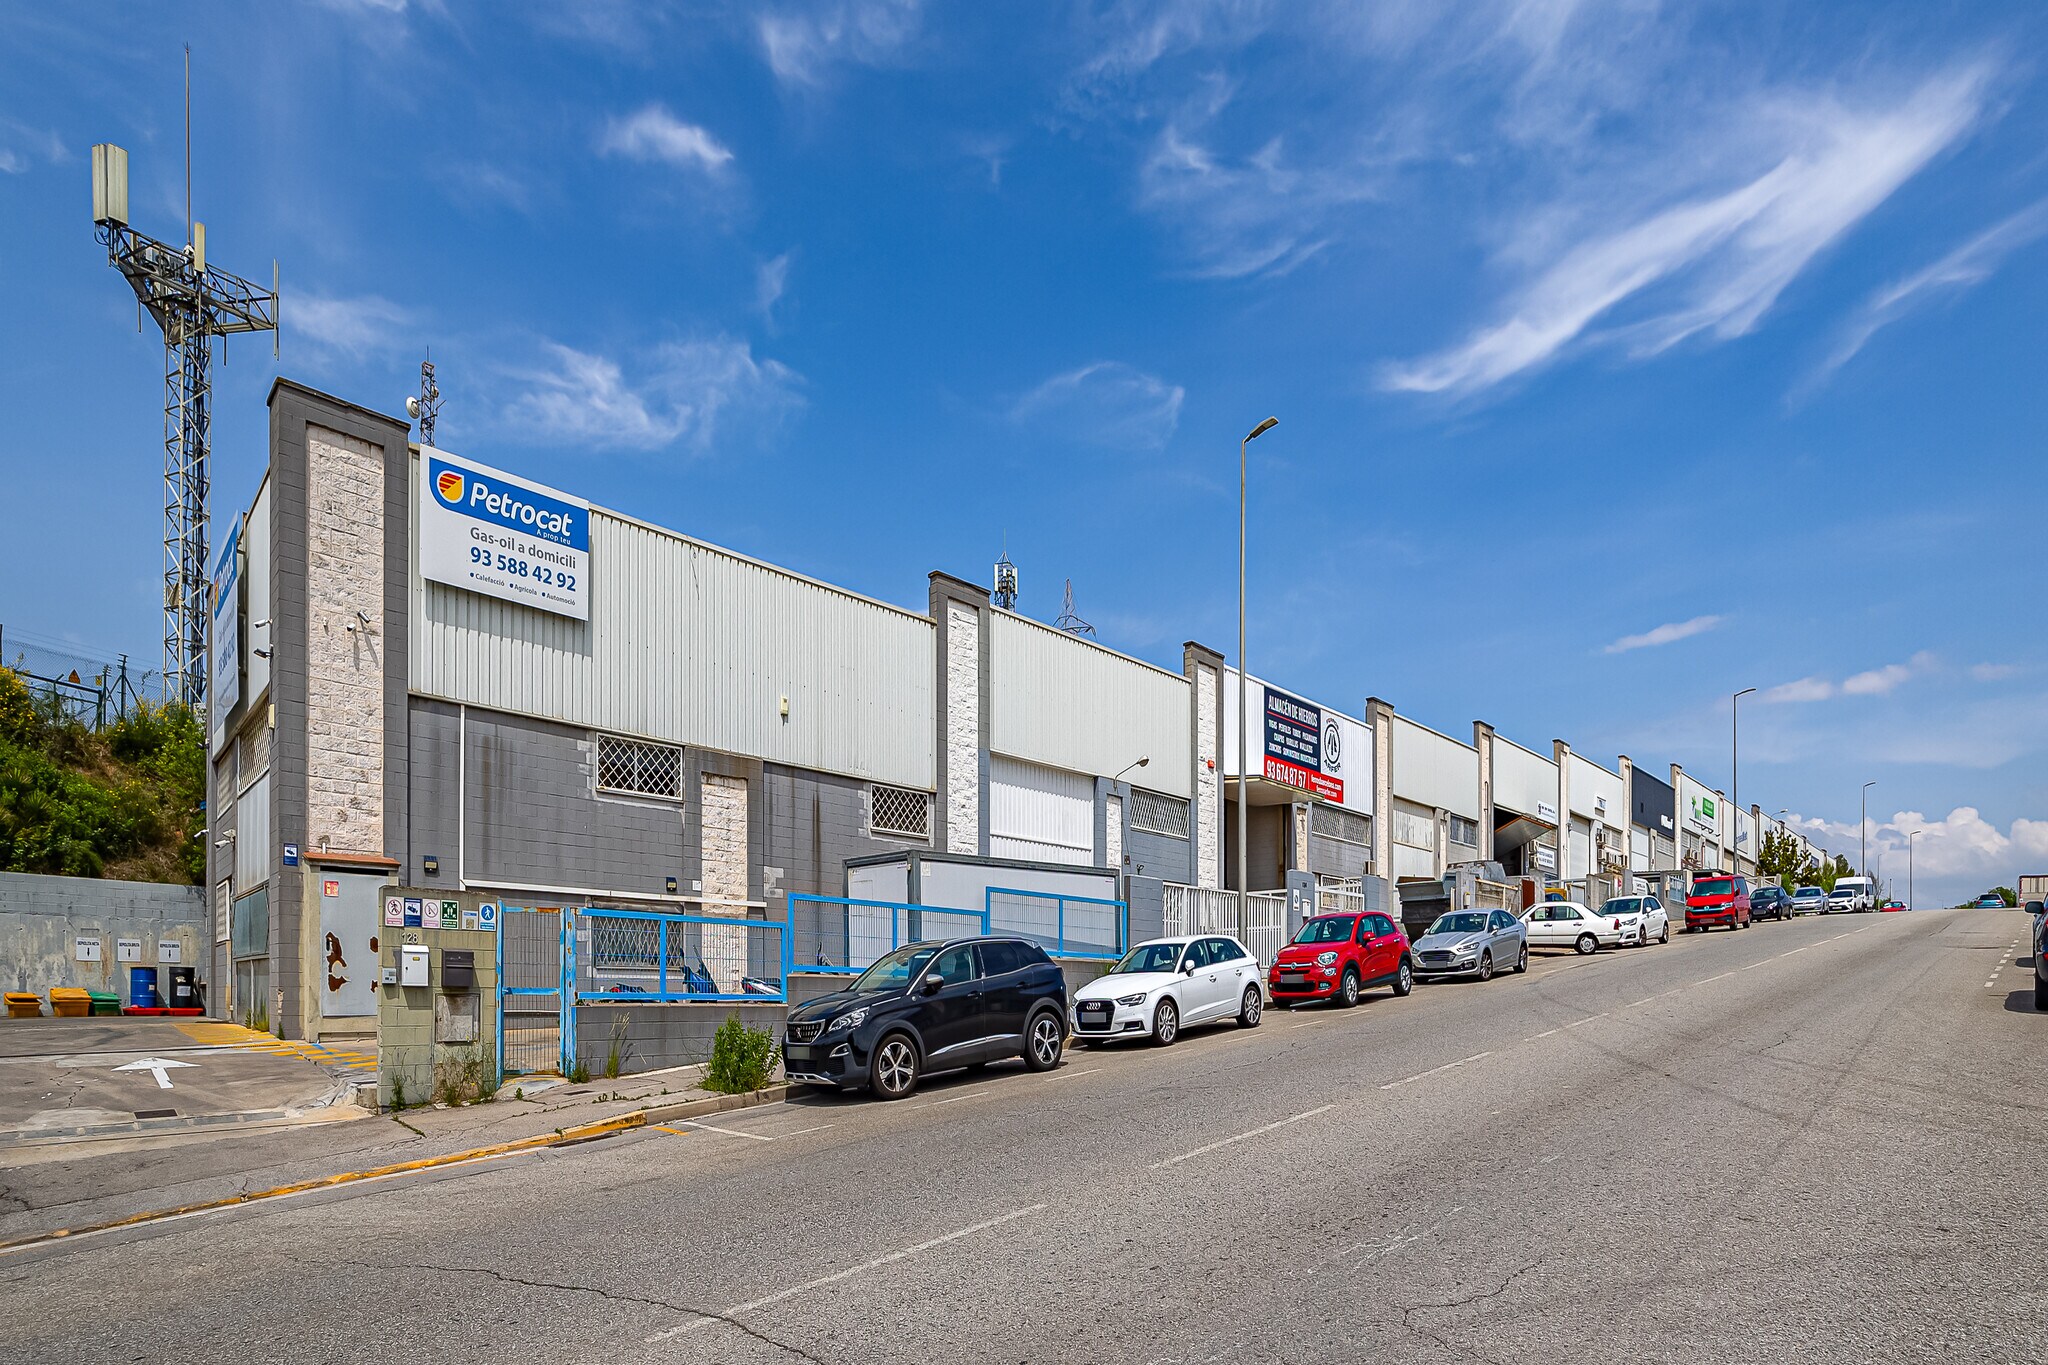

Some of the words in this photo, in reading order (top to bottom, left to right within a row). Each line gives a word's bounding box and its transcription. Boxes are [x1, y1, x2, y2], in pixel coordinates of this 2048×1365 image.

[470, 482, 573, 536] Petrocat
[470, 527, 515, 551] Gas-oil
[518, 543, 525, 554] a
[528, 544, 576, 569] domicili
[543, 532, 559, 542] prop
[560, 536, 571, 545] teu
[470, 546, 492, 567] 93
[496, 554, 528, 578] 588
[532, 565, 553, 586] 42
[556, 573, 577, 593] 92
[475, 573, 505, 587] Calefacció
[1292, 703, 1298, 720] DE
[1298, 706, 1318, 728] HIERROS
[1266, 760, 1275, 779] 93
[1276, 763, 1289, 784] 674
[1289, 767, 1297, 786] 87
[1298, 769, 1306, 788] 57
[401, 932, 419, 944] 128
